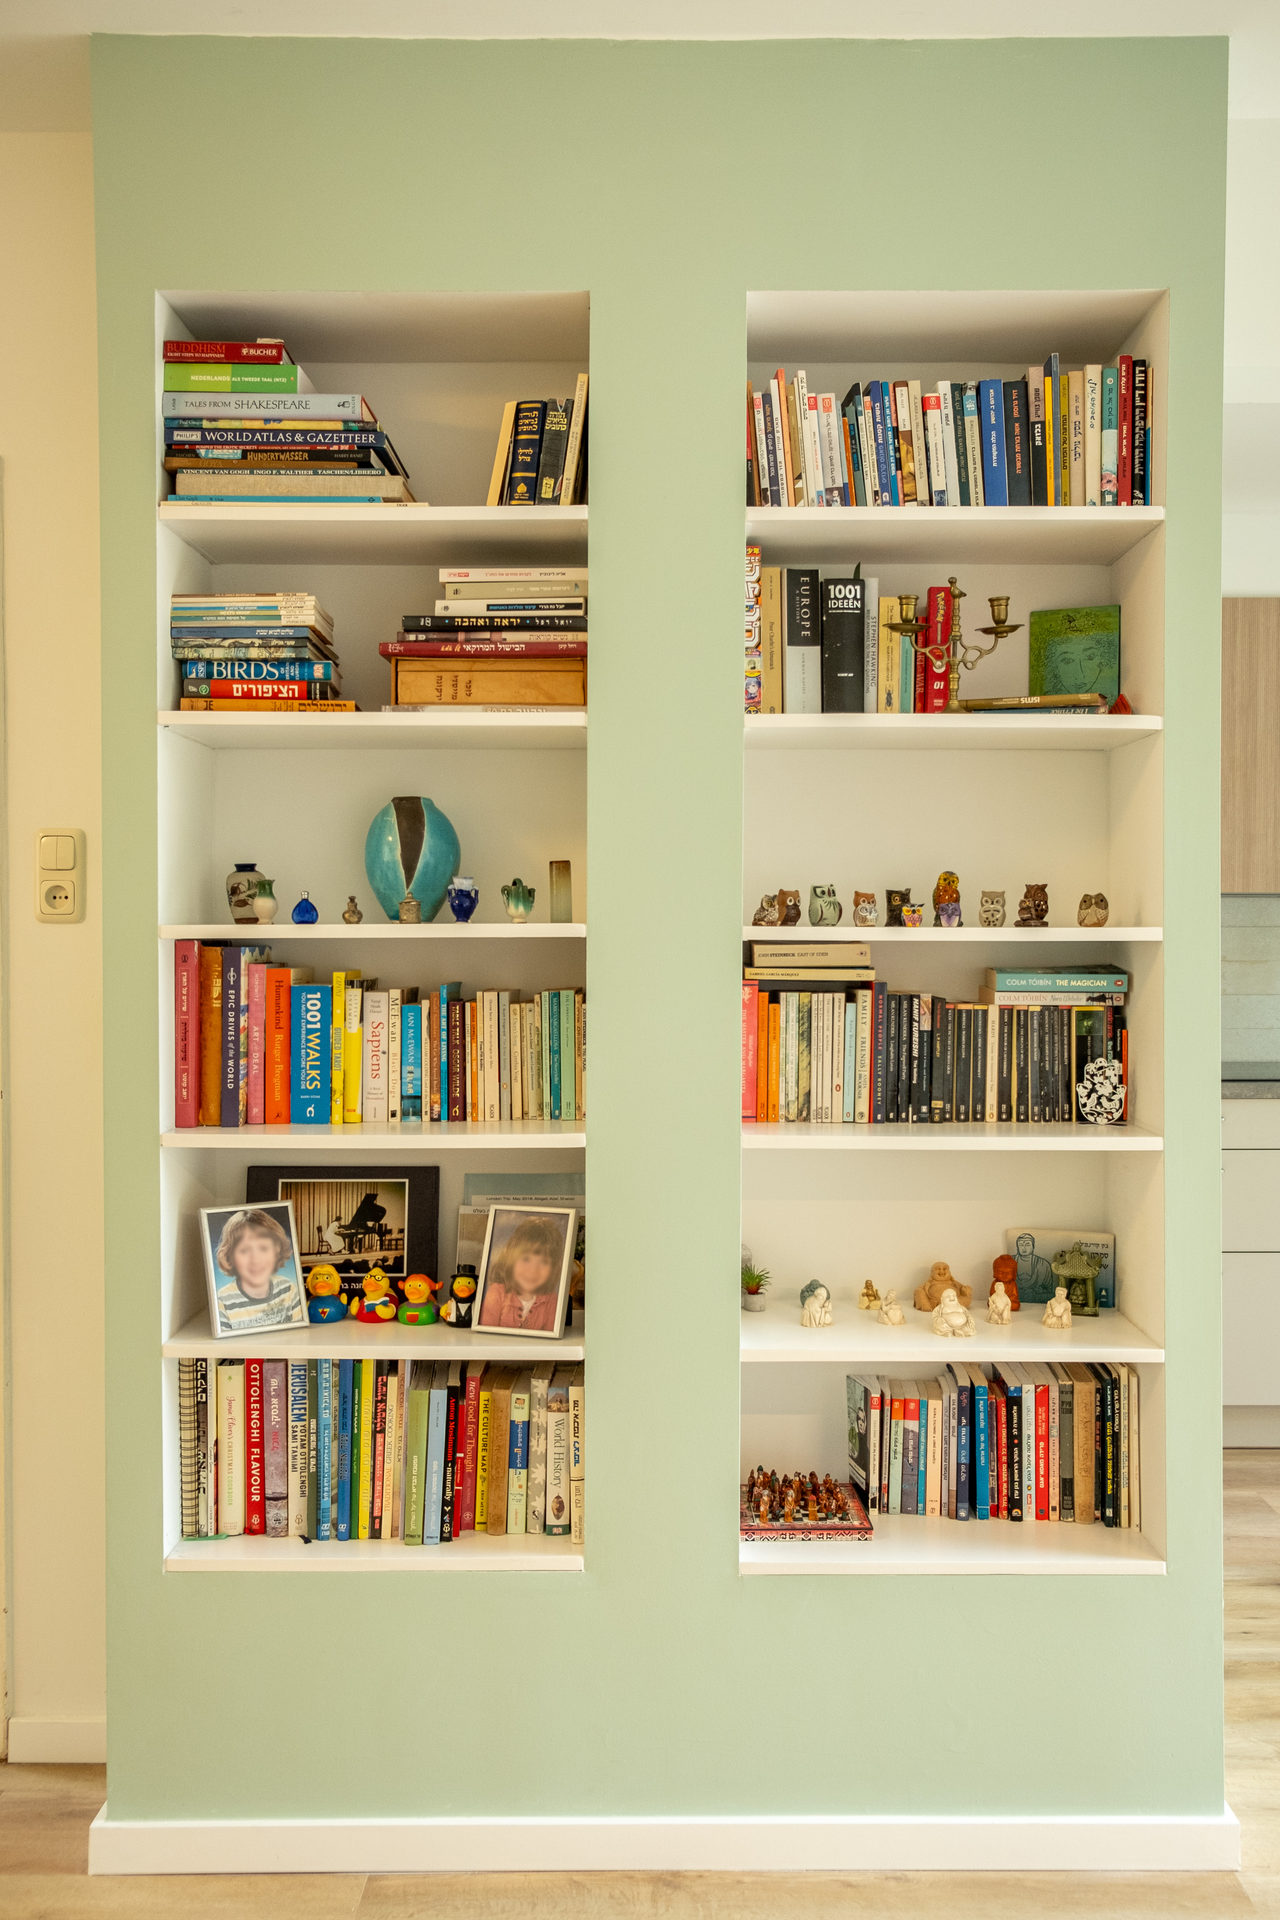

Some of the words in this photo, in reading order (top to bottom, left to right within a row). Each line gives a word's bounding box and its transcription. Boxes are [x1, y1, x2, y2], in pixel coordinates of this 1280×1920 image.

[167, 344, 225, 353] BUDDHISM
[1135, 367, 1145, 387] דודו
[234, 400, 310, 410] SHAKESPEARE
[1135, 390, 1145, 406] דיין
[205, 432, 252, 442] WORLD
[253, 432, 293, 442] ATLAS
[295, 433, 305, 442] &
[307, 433, 376, 443] GAZETTEER
[1135, 408, 1146, 446] הרפתקה
[247, 452, 309, 461] HUNDERTWASSER
[1135, 448, 1143, 474] הודית
[828, 585, 861, 599] 1001
[800, 577, 811, 637] EUROPE
[454, 617, 490, 626] ואהבה
[494, 617, 521, 626] יראה
[462, 644, 495, 654] המרוקאי
[497, 642, 526, 652] הבישול
[213, 661, 279, 680] BIRDS
[232, 683, 299, 697] הציפורים
[934, 681, 944, 690] 01
[298, 699, 347, 712] ירושלים
[275, 980, 283, 1029] Humankind
[306, 992, 321, 1029] 1001
[391, 997, 399, 1043] McEwan
[274, 1034, 282, 1062] Rutger
[306, 1032, 320, 1090] WALKS
[367, 1021, 384, 1079] Sapiens
[391, 1052, 399, 1074] Black
[273, 1065, 282, 1101] Bregman
[390, 1079, 398, 1098] Dogs
[196, 1360, 206, 1402] מרקים
[291, 1363, 307, 1422] JERUSALEM
[374, 1375, 387, 1401] בישול
[469, 1381, 477, 1400] new
[226, 1396, 235, 1415] Jamie
[250, 1364, 260, 1442] OTTOLENGHI
[448, 1397, 457, 1420] Anton
[468, 1401, 476, 1422] Food
[374, 1402, 386, 1431] איטלקי
[386, 1404, 394, 1438] COOKING
[299, 1424, 307, 1449] YOTAM
[447, 1421, 455, 1461] Mosimann
[467, 1424, 476, 1436] for
[481, 1416, 489, 1453] CULTURE
[554, 1418, 565, 1448] World
[464, 1437, 474, 1472] Thought
[251, 1448, 260, 1502] FLAVOUR
[299, 1451, 307, 1498] OTTOLENGHI
[550, 1452, 564, 1488] History
[384, 1467, 392, 1512] TRADITIONAL
